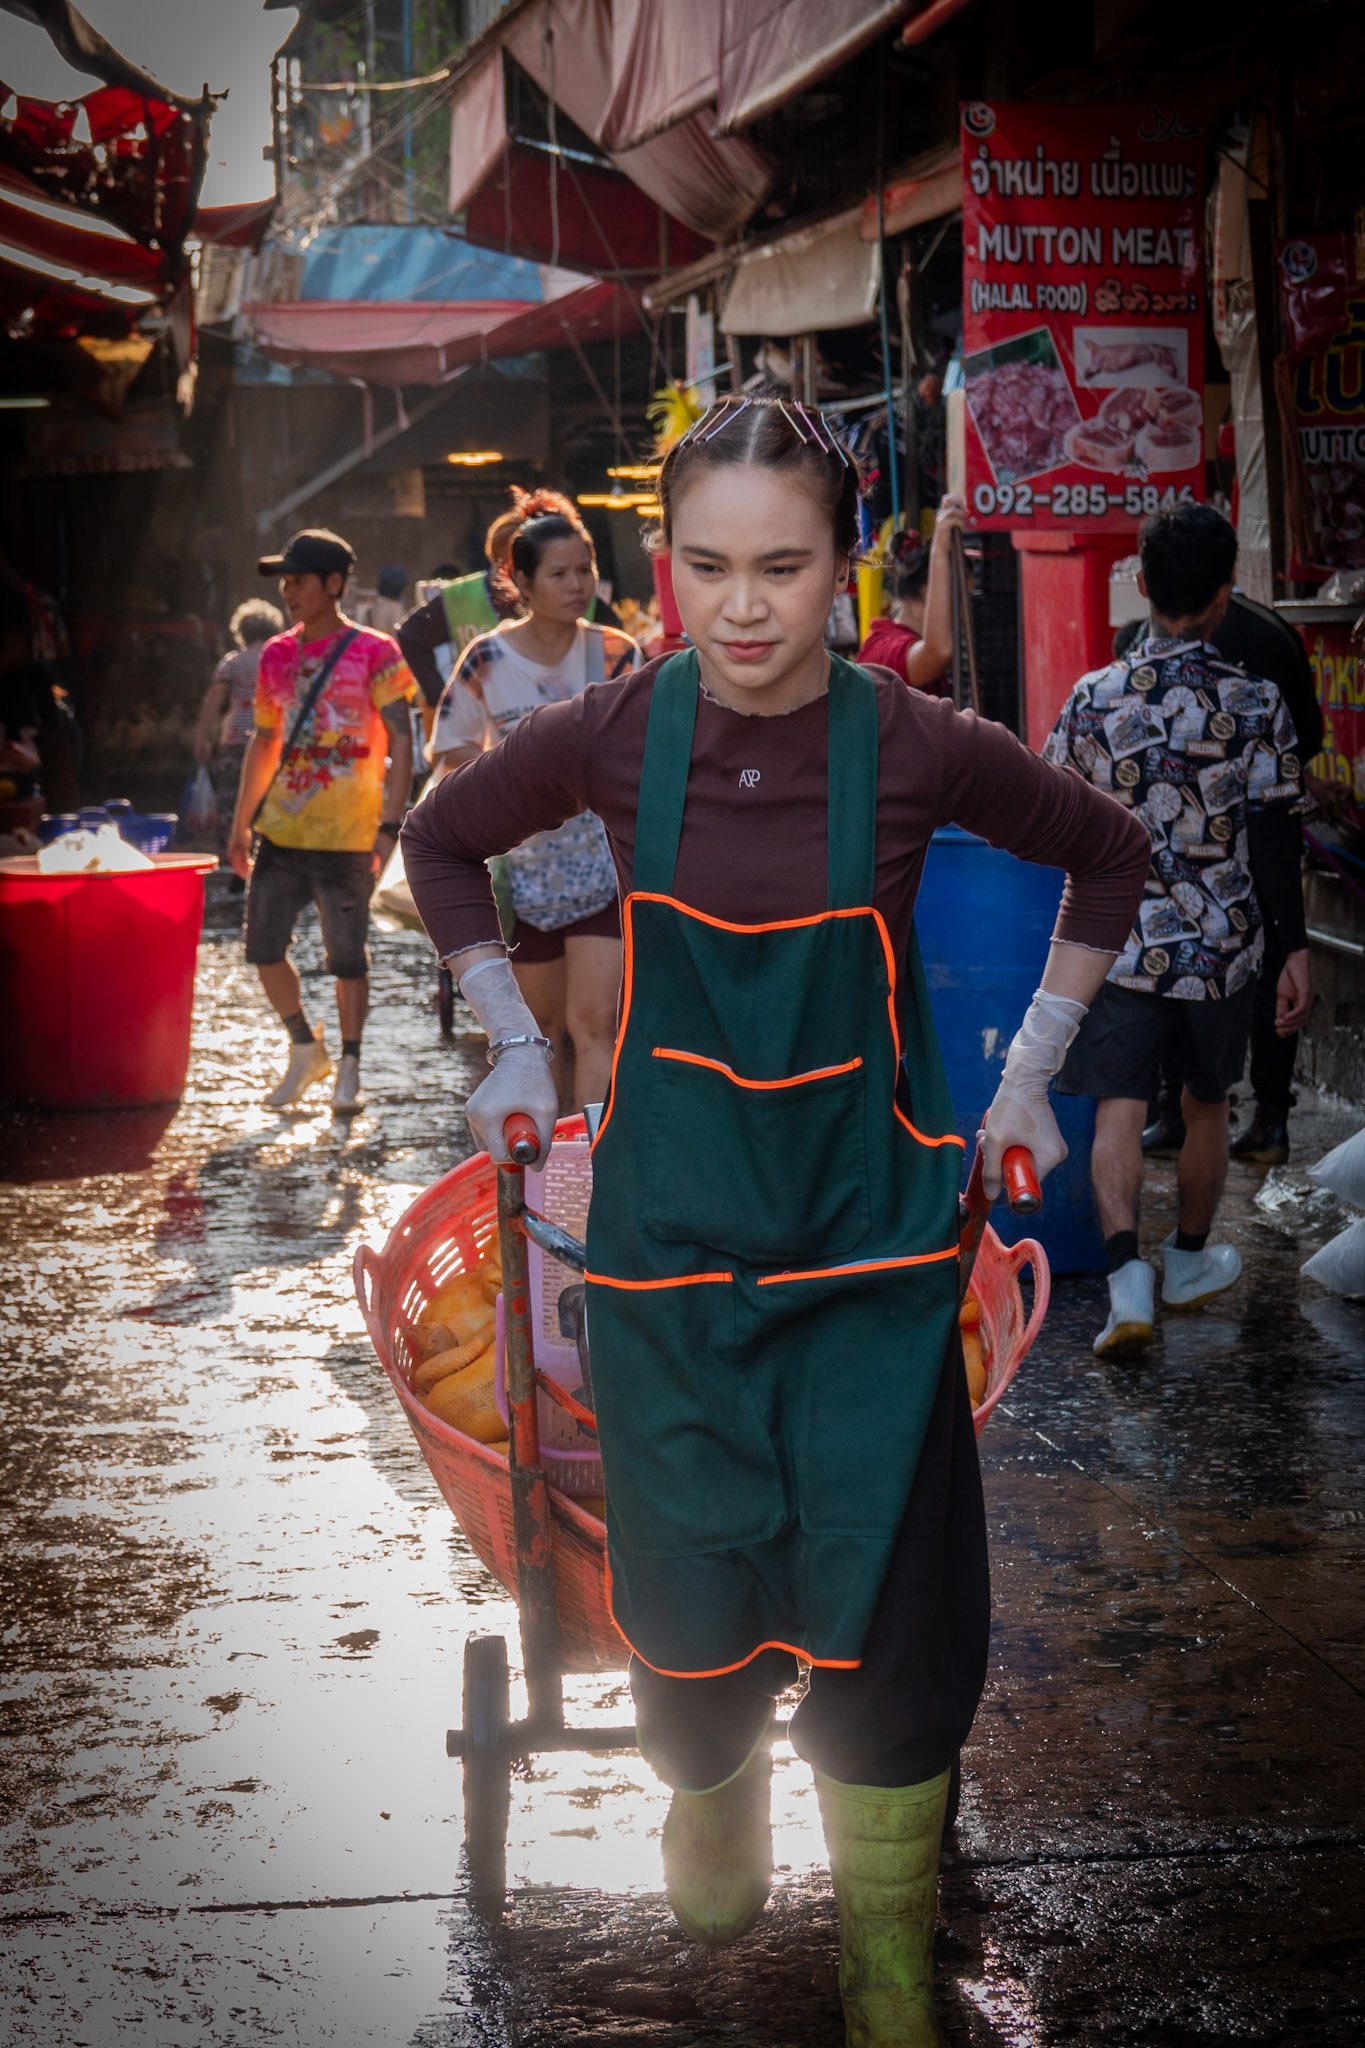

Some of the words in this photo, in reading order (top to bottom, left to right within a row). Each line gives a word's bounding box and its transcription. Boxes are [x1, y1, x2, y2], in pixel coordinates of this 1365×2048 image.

[969, 143, 1080, 196] จำหน่าย
[977, 223, 1102, 265] MUTTON
[1111, 226, 1192, 265] MEAT
[971, 278, 1033, 313] (HALAL
[1036, 280, 1088, 316] FOOD)
